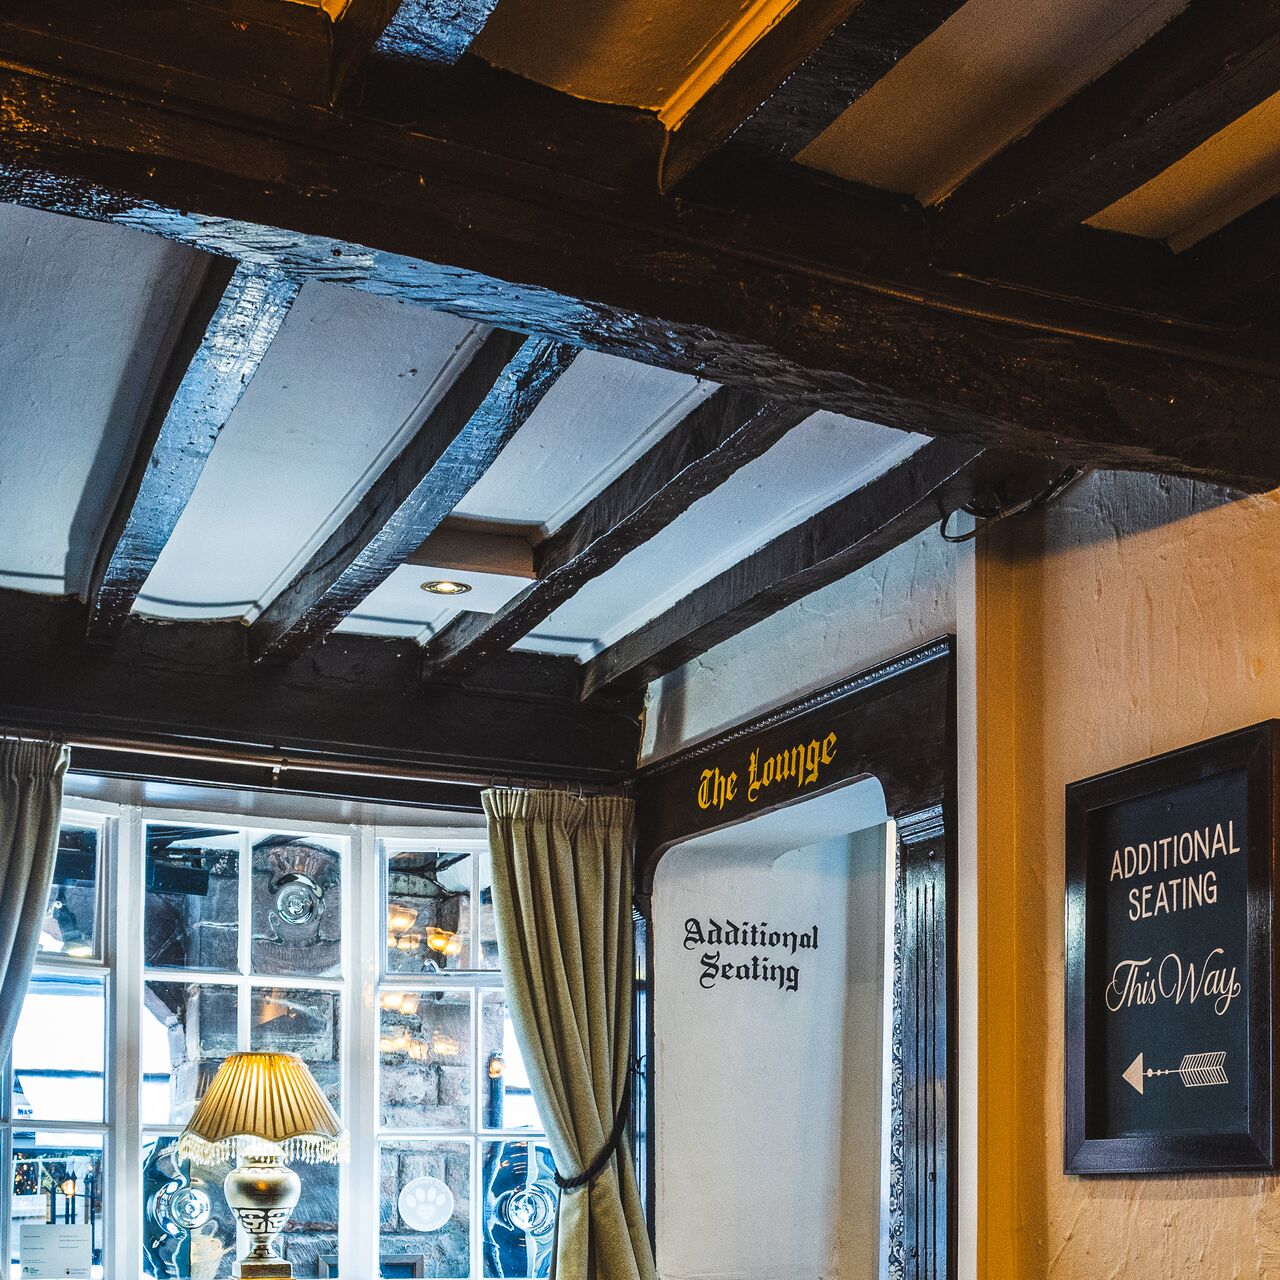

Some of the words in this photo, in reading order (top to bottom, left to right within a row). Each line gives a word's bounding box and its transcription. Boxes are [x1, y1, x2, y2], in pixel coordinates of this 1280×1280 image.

[697, 767, 738, 810] The
[748, 731, 838, 803] Lounge
[1110, 820, 1241, 883] ADDITIONAL
[1126, 870, 1218, 922] SEATING
[683, 917, 819, 952] Additional
[699, 951, 800, 992] Seating
[1106, 957, 1156, 1012] This
[1158, 948, 1242, 1016] Way
